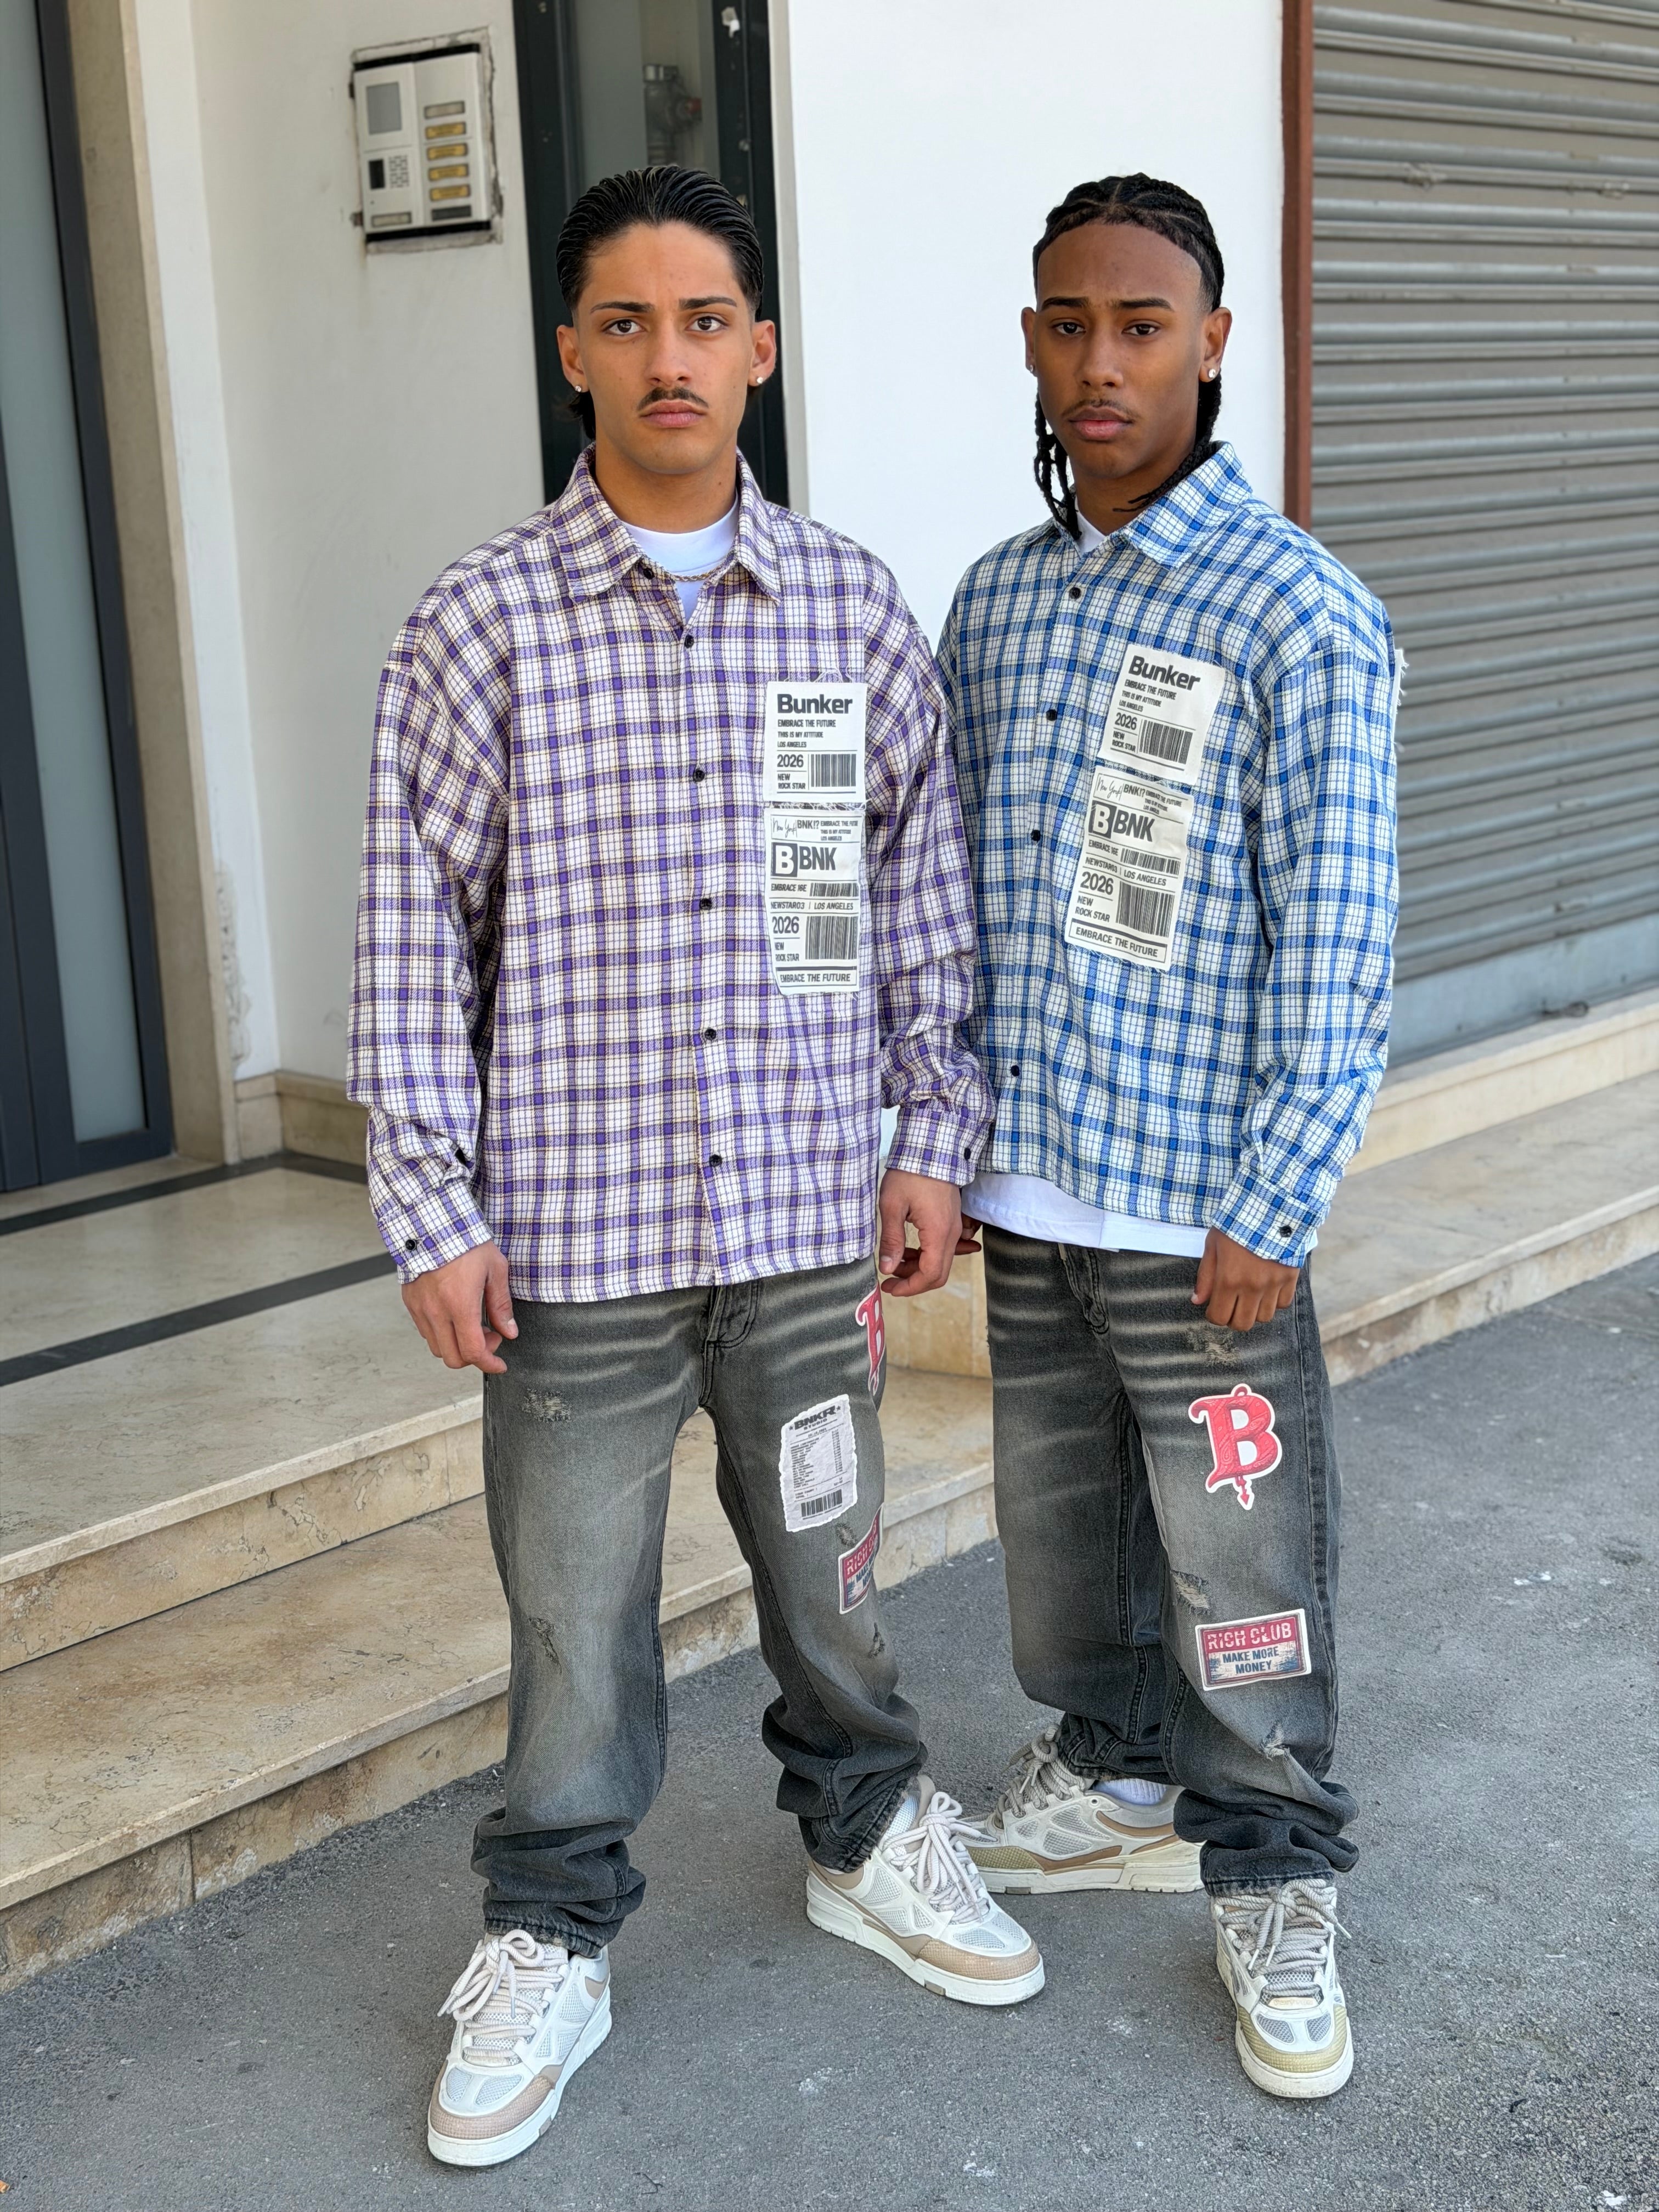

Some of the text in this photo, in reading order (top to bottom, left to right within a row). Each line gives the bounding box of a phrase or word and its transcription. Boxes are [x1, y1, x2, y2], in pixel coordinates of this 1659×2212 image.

[1128, 655, 1201, 691] Bunker
[1125, 679, 1177, 700] EMBRACE THE FUTURE
[777, 693, 853, 714] Bunker
[1126, 702, 1143, 712] ANGELES
[1142, 697, 1162, 707] ATTITUDE
[1115, 712, 1137, 731] 2026
[1113, 731, 1125, 740] NEW
[1112, 740, 1136, 753] ROCK STAR
[777, 754, 804, 768] 2026
[1124, 784, 1146, 798] BNK!?
[1166, 797, 1182, 807] FUTURE
[797, 820, 820, 830] BNK!?
[1091, 802, 1155, 842] B BNK
[1088, 839, 1110, 853] EMBRACE
[775, 844, 837, 875] B BNK
[1085, 857, 1166, 887] NEWSTAR03 LOS ANGELES
[771, 883, 795, 891] EMBRACE
[1080, 871, 1114, 895] 2026
[826, 902, 854, 910] ANGELES
[1077, 895, 1094, 906] NEW
[1075, 906, 1110, 922] ROCK STAR
[772, 916, 800, 934] 2026
[1075, 927, 1158, 957] EMBRACE THE FUTURE
[775, 953, 786, 962] ROCK
[780, 973, 851, 983] EMBRACE THE FUTURE
[857, 1284, 884, 1378] B
[794, 1406, 836, 1430] BNKR
[804, 1418, 827, 1430] STUDIO
[1190, 1386, 1280, 1495] B
[847, 1543, 867, 1575] RICH
[1207, 1622, 1291, 1650] RICH CLUB
[1222, 1646, 1280, 1663] MAKE MORE
[1235, 1660, 1272, 1674] MONEY
